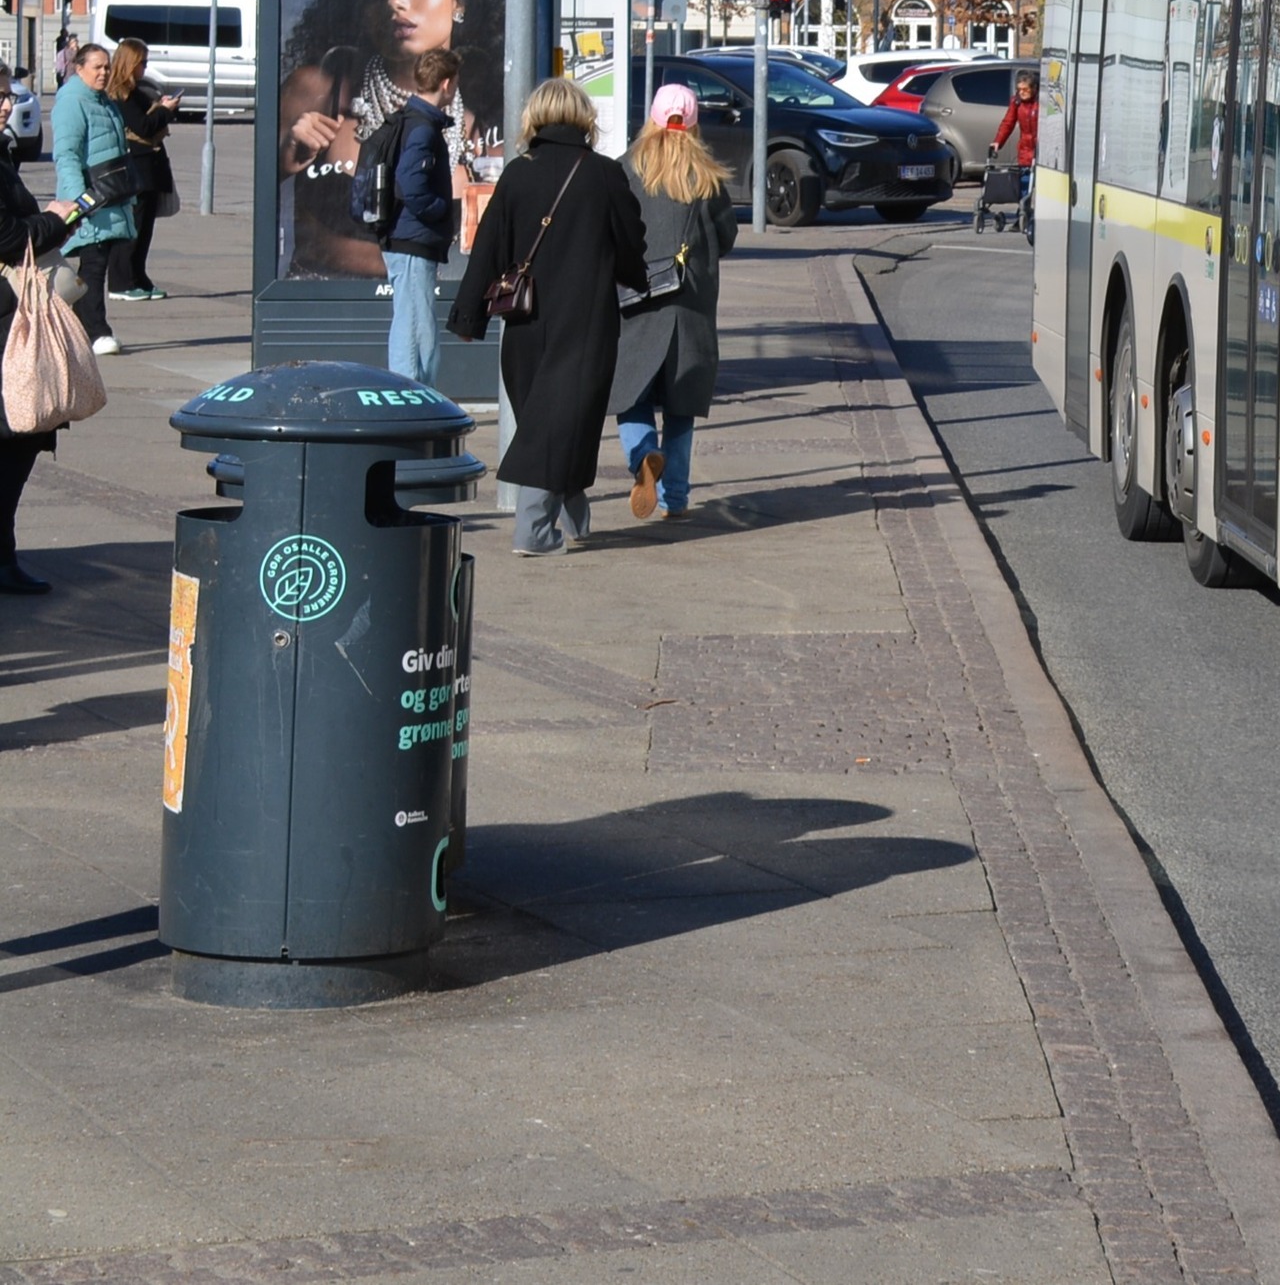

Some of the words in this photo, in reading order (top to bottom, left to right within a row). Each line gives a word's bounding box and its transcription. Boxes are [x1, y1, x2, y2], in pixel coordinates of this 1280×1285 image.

[283, 542, 299, 555] OS
[301, 542, 329, 561] ALLE
[401, 647, 434, 674] Giv
[400, 689, 427, 713] og
[428, 685, 451, 711] gør
